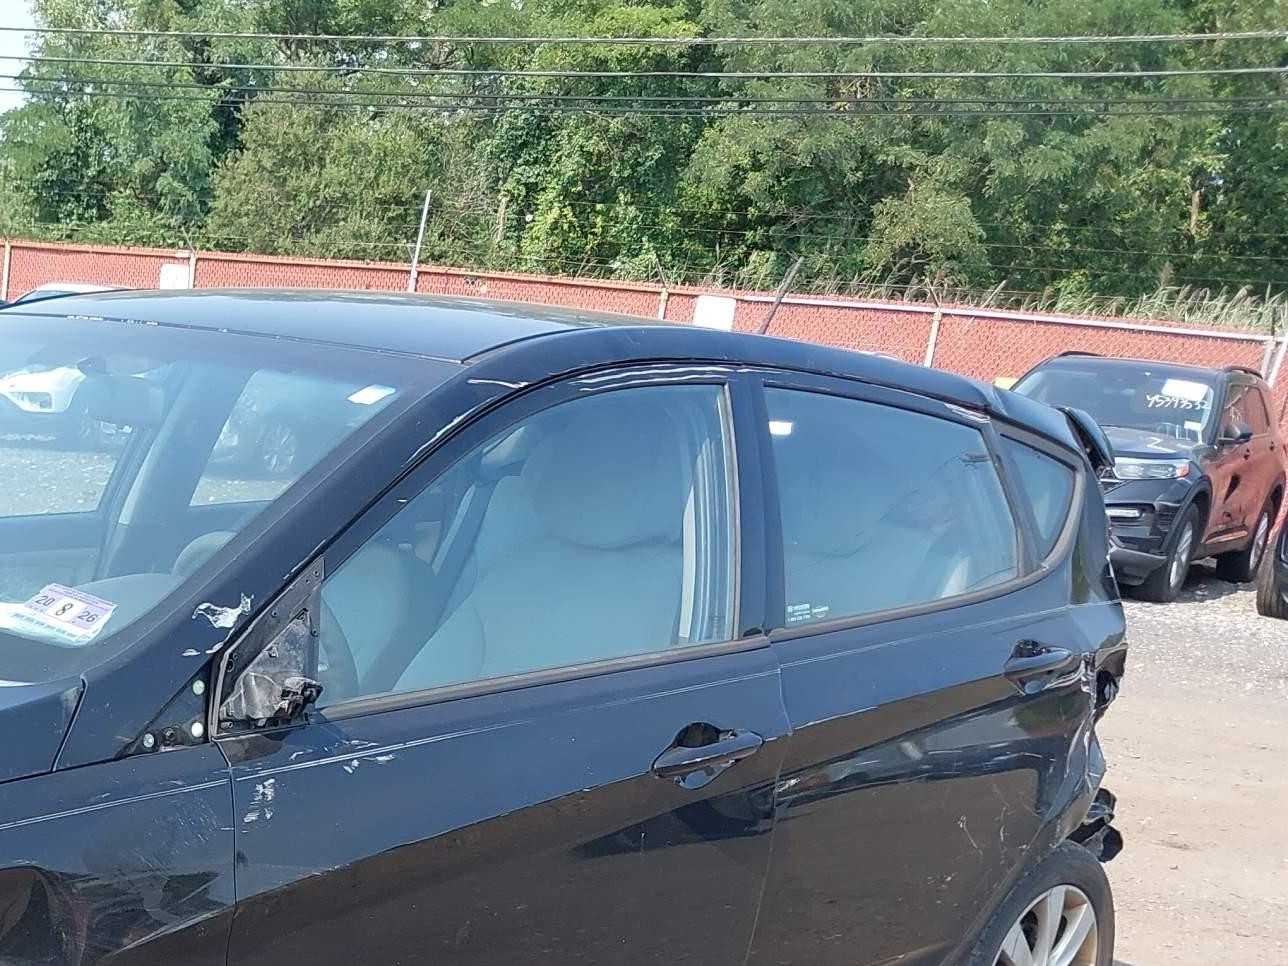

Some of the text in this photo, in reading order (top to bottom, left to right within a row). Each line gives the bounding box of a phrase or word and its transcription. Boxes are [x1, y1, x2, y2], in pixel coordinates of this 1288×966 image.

[35, 595, 56, 607] 20
[55, 602, 74, 616] 8
[78, 610, 99, 623] 26
